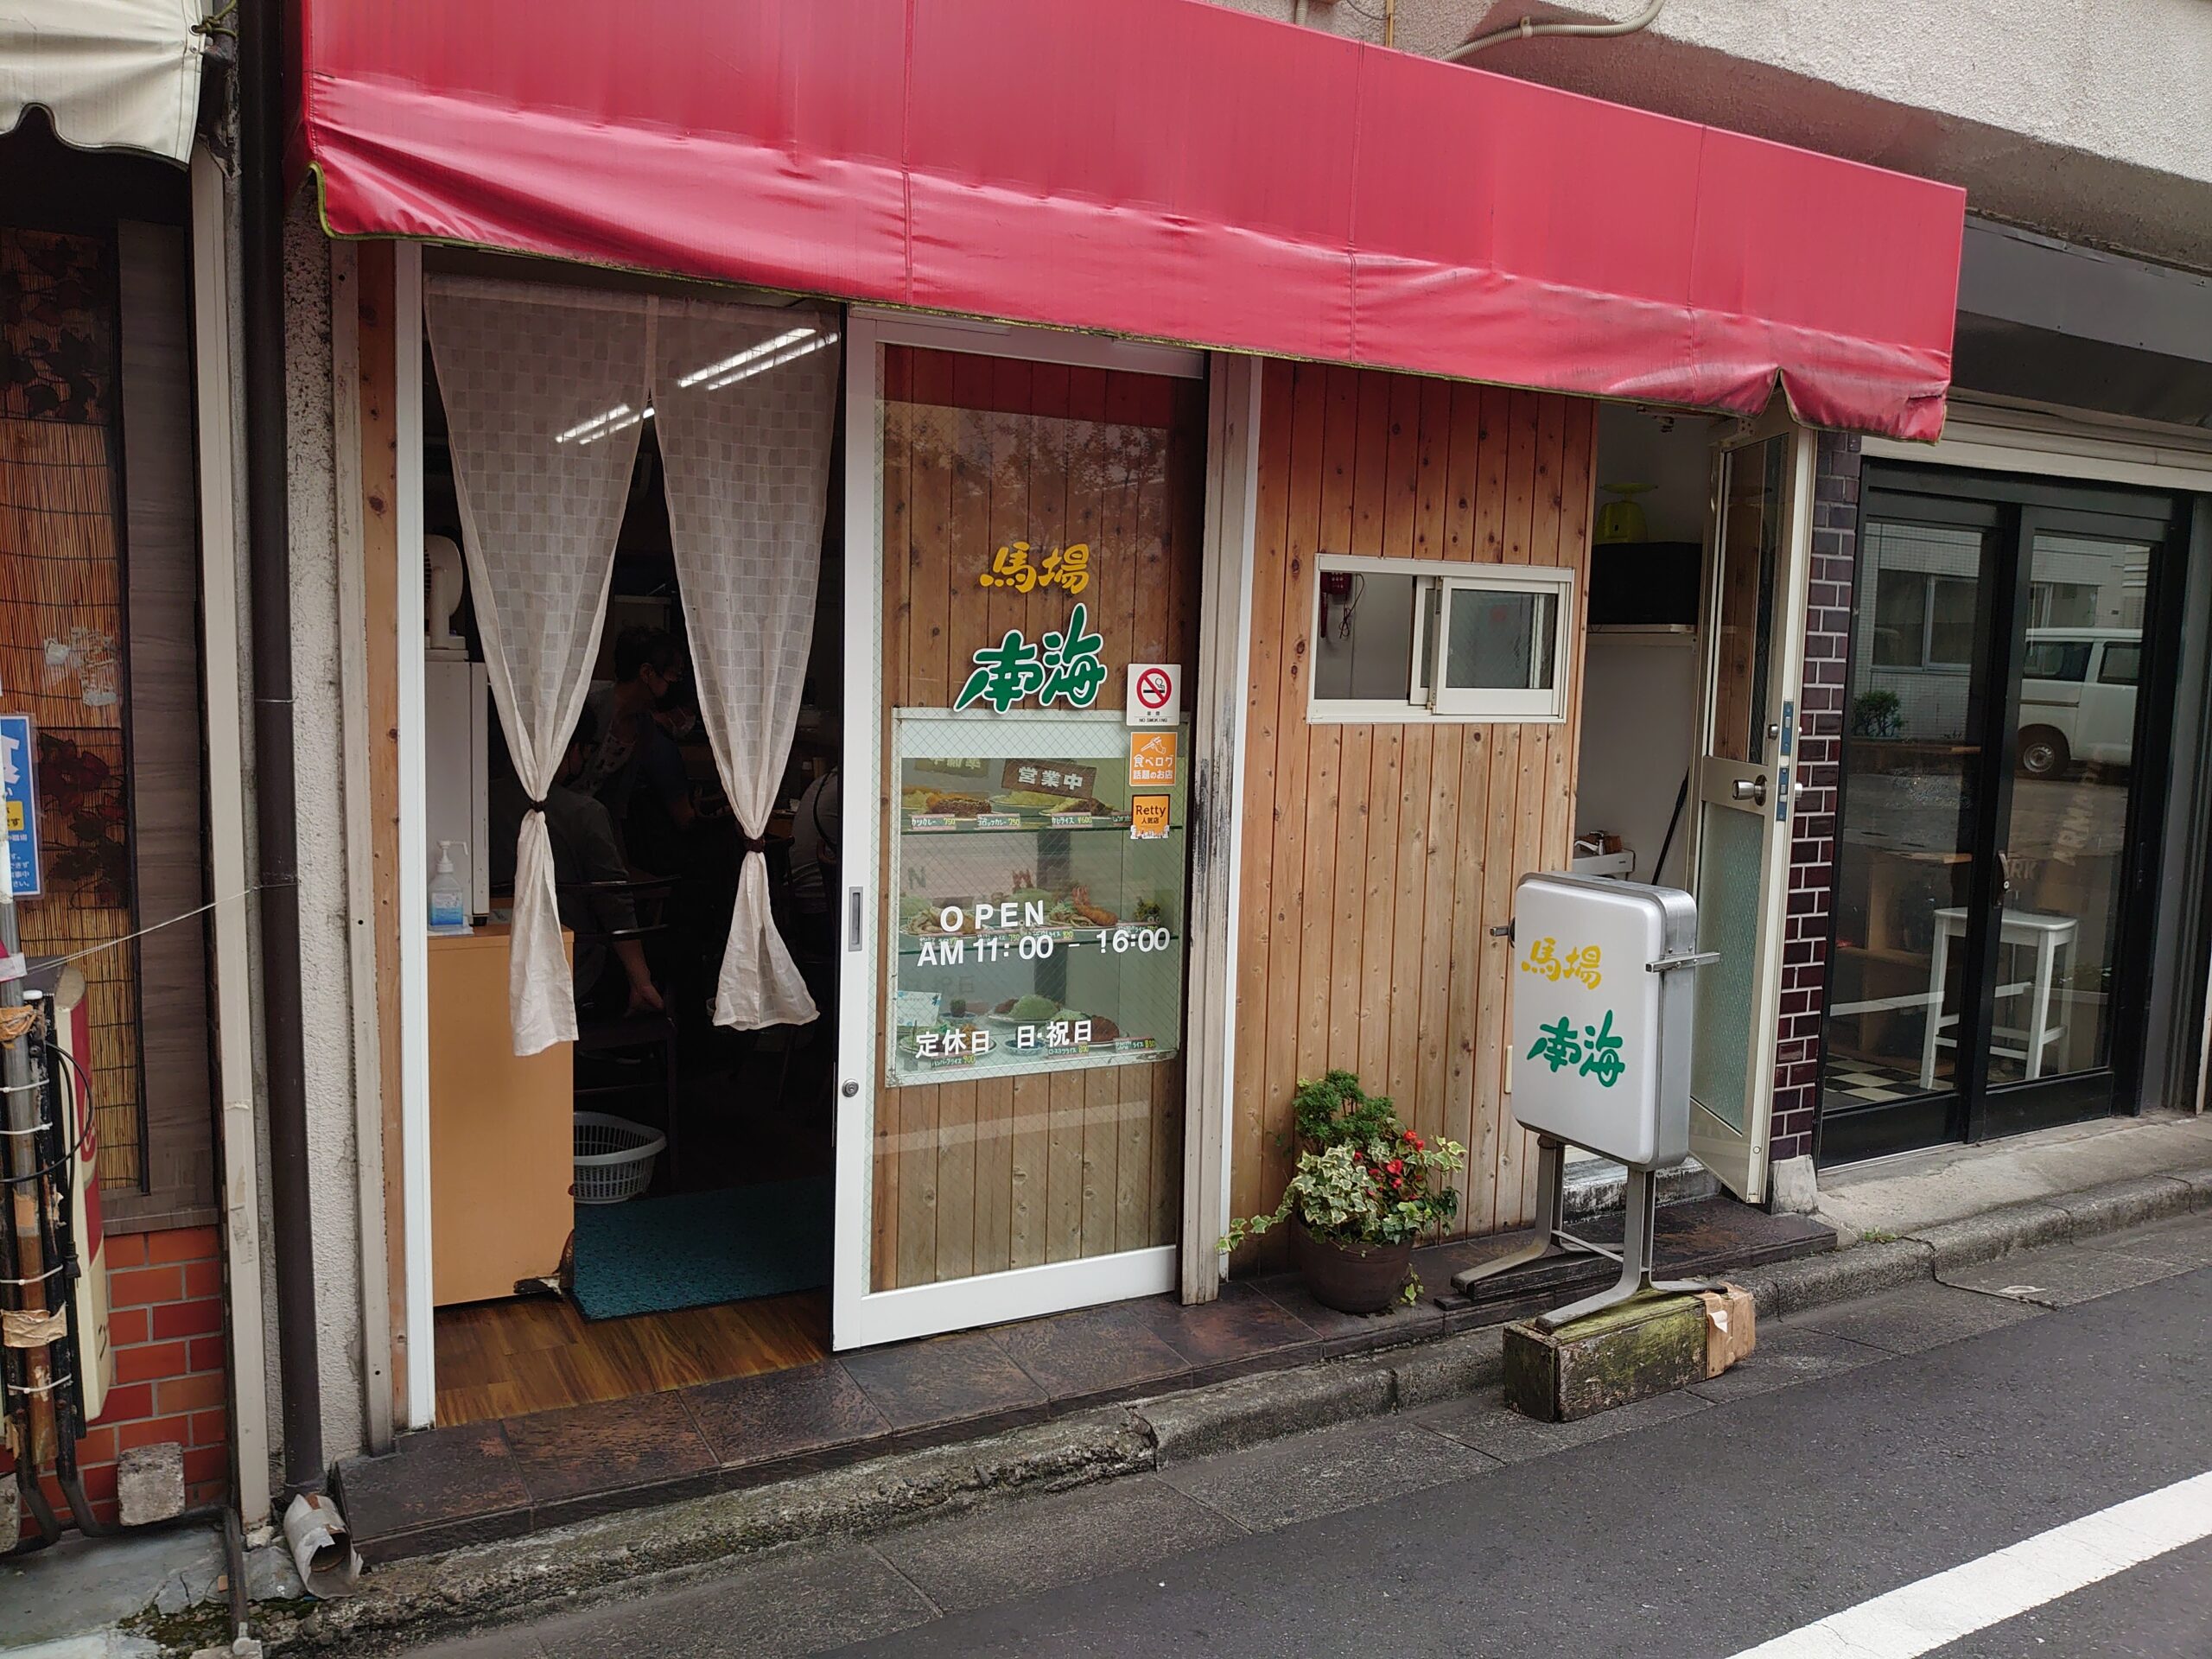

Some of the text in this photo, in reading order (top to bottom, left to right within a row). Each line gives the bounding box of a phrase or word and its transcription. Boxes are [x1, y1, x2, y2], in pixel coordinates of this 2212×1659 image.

[980, 541, 1090, 594] 馬場
[953, 602, 1107, 714] 南海
[1133, 753, 1174, 768] 食べログ
[1133, 769, 1173, 780] 話題のお店
[1018, 766, 1084, 791] 営業中
[1135, 804, 1166, 817] Retty
[940, 900, 1045, 933] OPEN
[917, 939, 964, 967] AM
[1521, 937, 1603, 990] 馬場
[915, 1028, 989, 1059] 定休日
[1527, 1009, 1626, 1088] 南海
